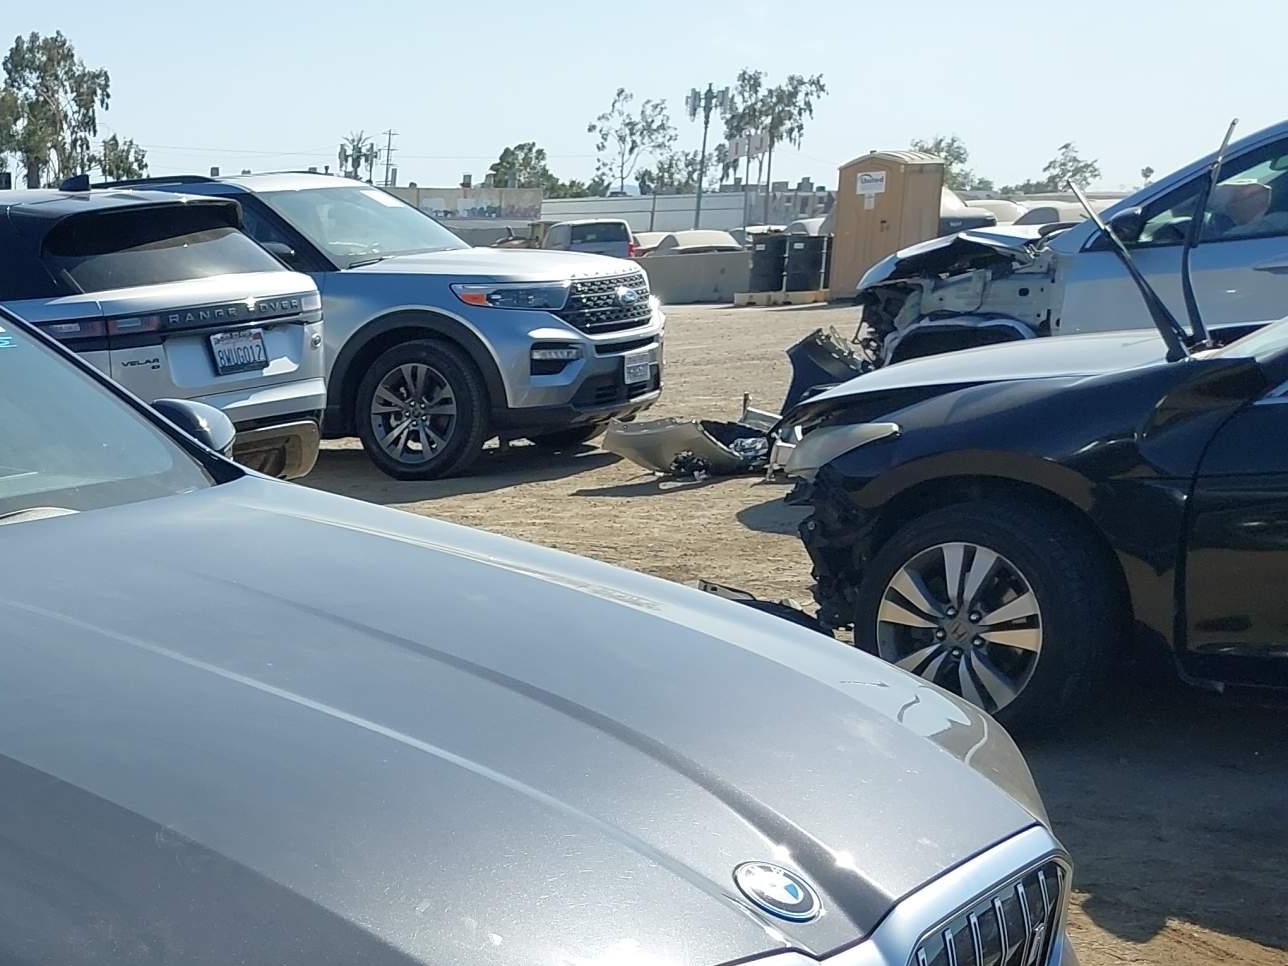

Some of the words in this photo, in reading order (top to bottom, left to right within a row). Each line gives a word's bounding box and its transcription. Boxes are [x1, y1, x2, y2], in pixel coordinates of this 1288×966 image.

[168, 307, 238, 325] RANGE
[246, 299, 299, 314] OVER
[121, 358, 160, 367] VELAR
